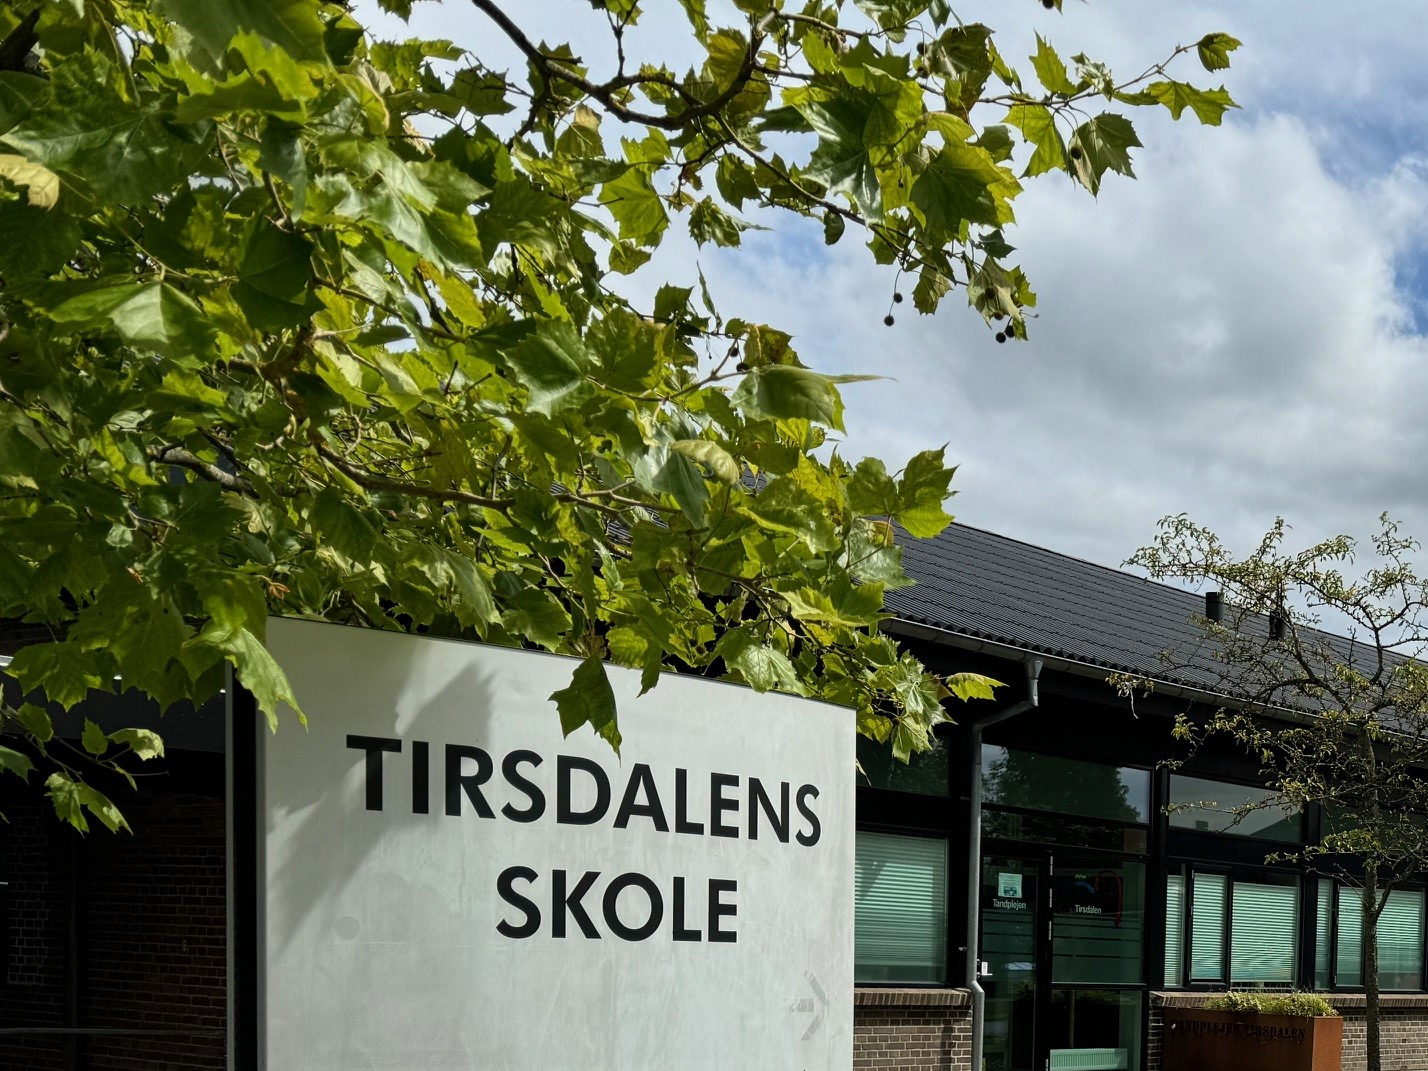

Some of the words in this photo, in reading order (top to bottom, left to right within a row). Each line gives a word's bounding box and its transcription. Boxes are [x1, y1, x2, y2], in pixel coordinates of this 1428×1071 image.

[346, 734, 820, 846] TIRSDALENS
[496, 866, 737, 942] SKOLE
[993, 898, 1027, 910] Tandplejen
[1074, 904, 1102, 914] Tirsdalen
